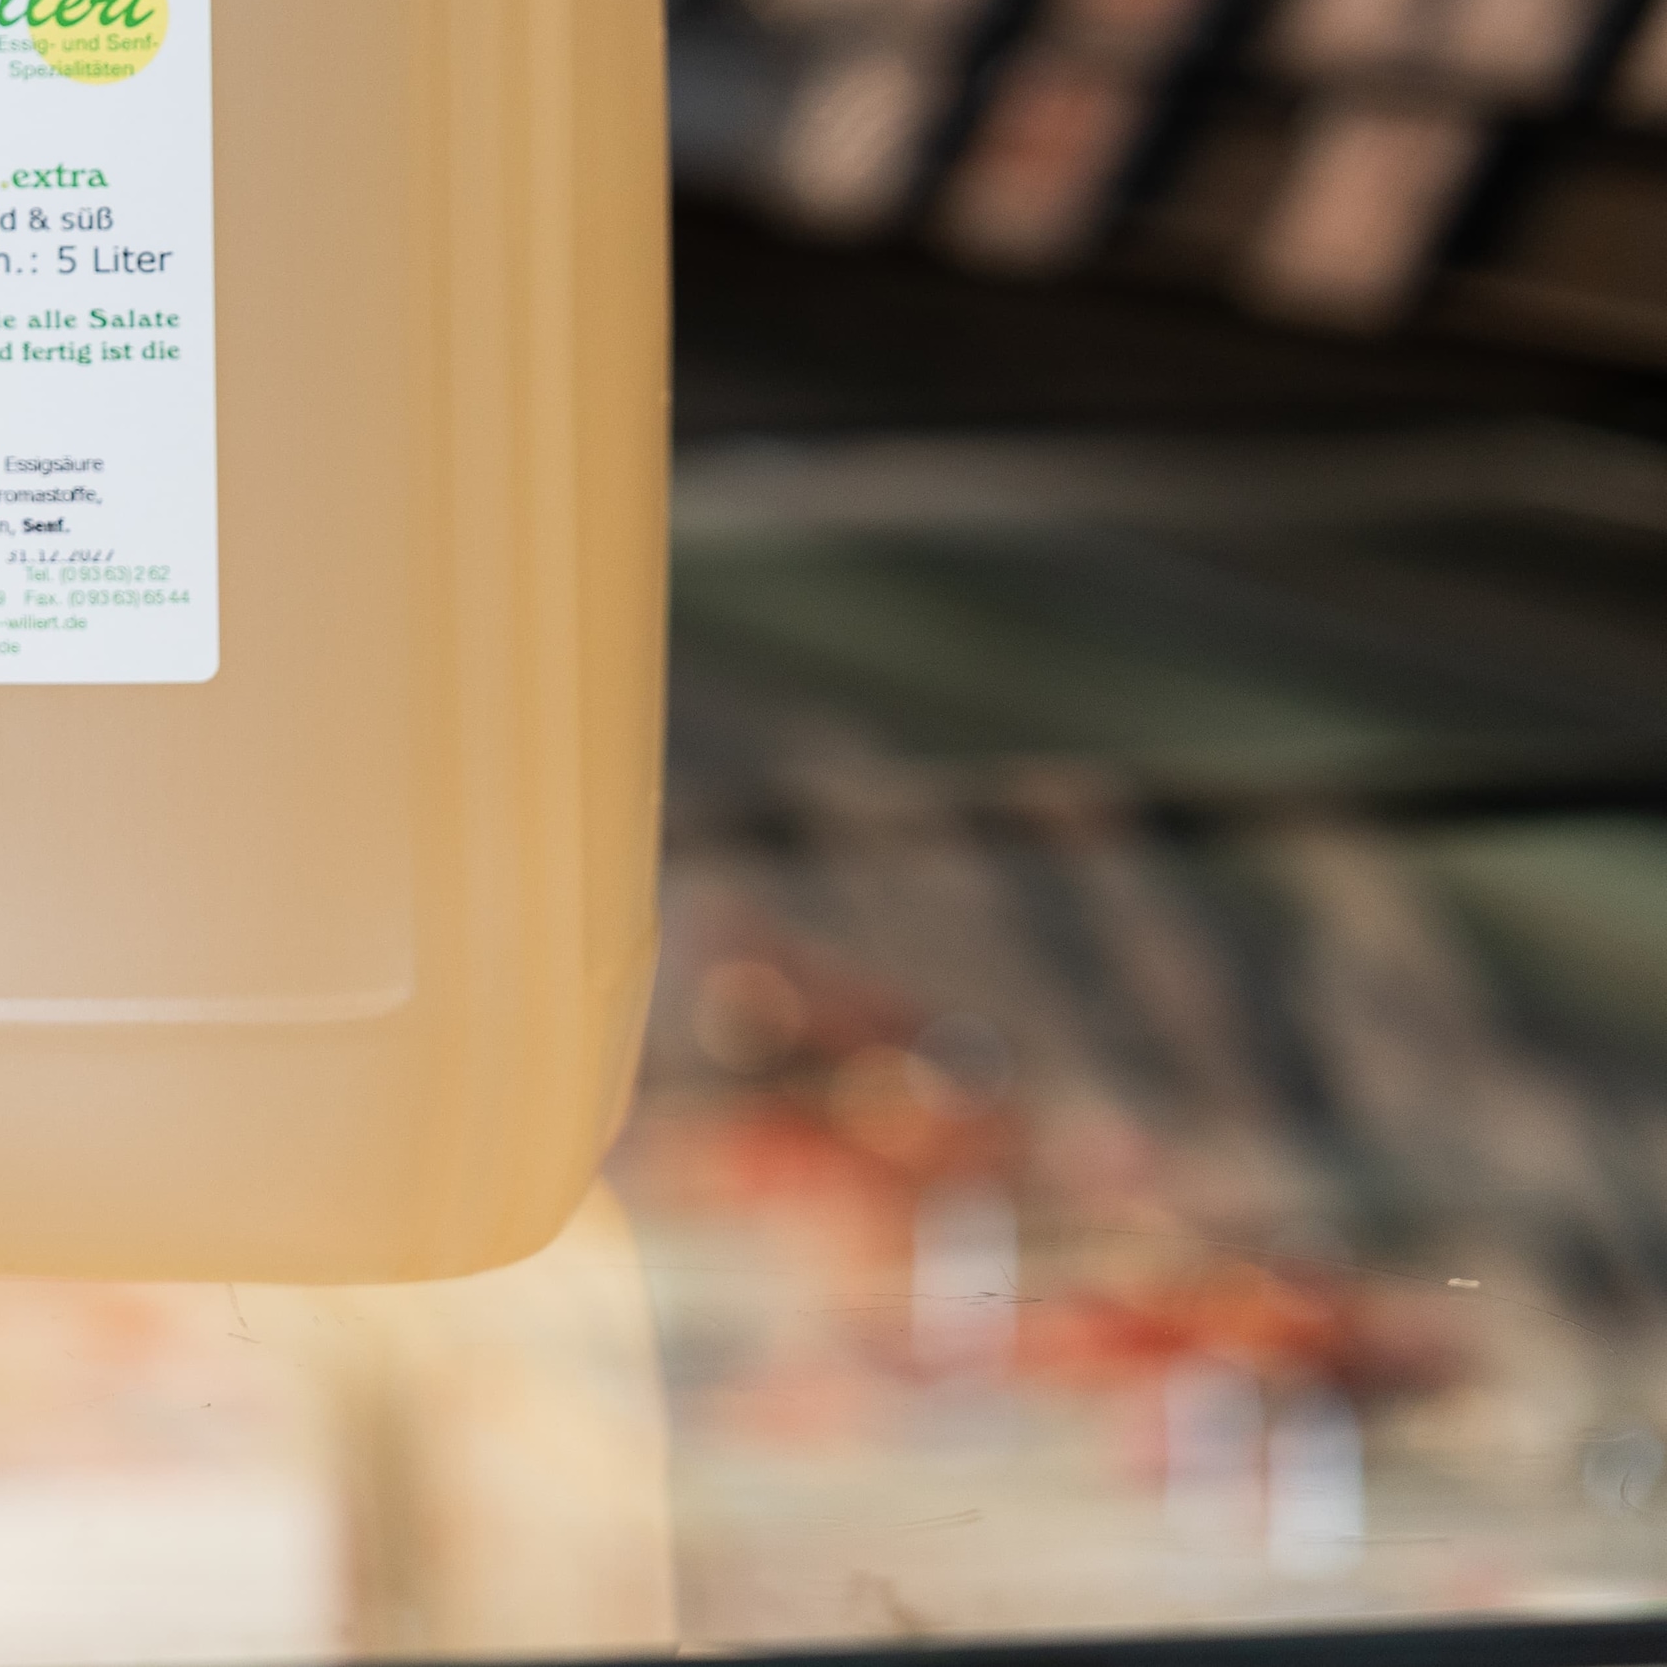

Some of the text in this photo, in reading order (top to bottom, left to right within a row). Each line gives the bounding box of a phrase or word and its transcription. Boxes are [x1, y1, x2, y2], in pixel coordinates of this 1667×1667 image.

[62, 36, 100, 52] und
[108, 34, 158, 52] Senf-
[9, 61, 134, 80] Spezialitäten
[29, 209, 49, 231] &
[61, 207, 114, 231] süß
[57, 246, 77, 273] 5
[94, 246, 173, 273] Liter
[28, 309, 76, 328] alle
[89, 309, 180, 328] Salate
[23, 342, 91, 364] fertig
[102, 342, 131, 361] ist
[142, 341, 180, 359] die
